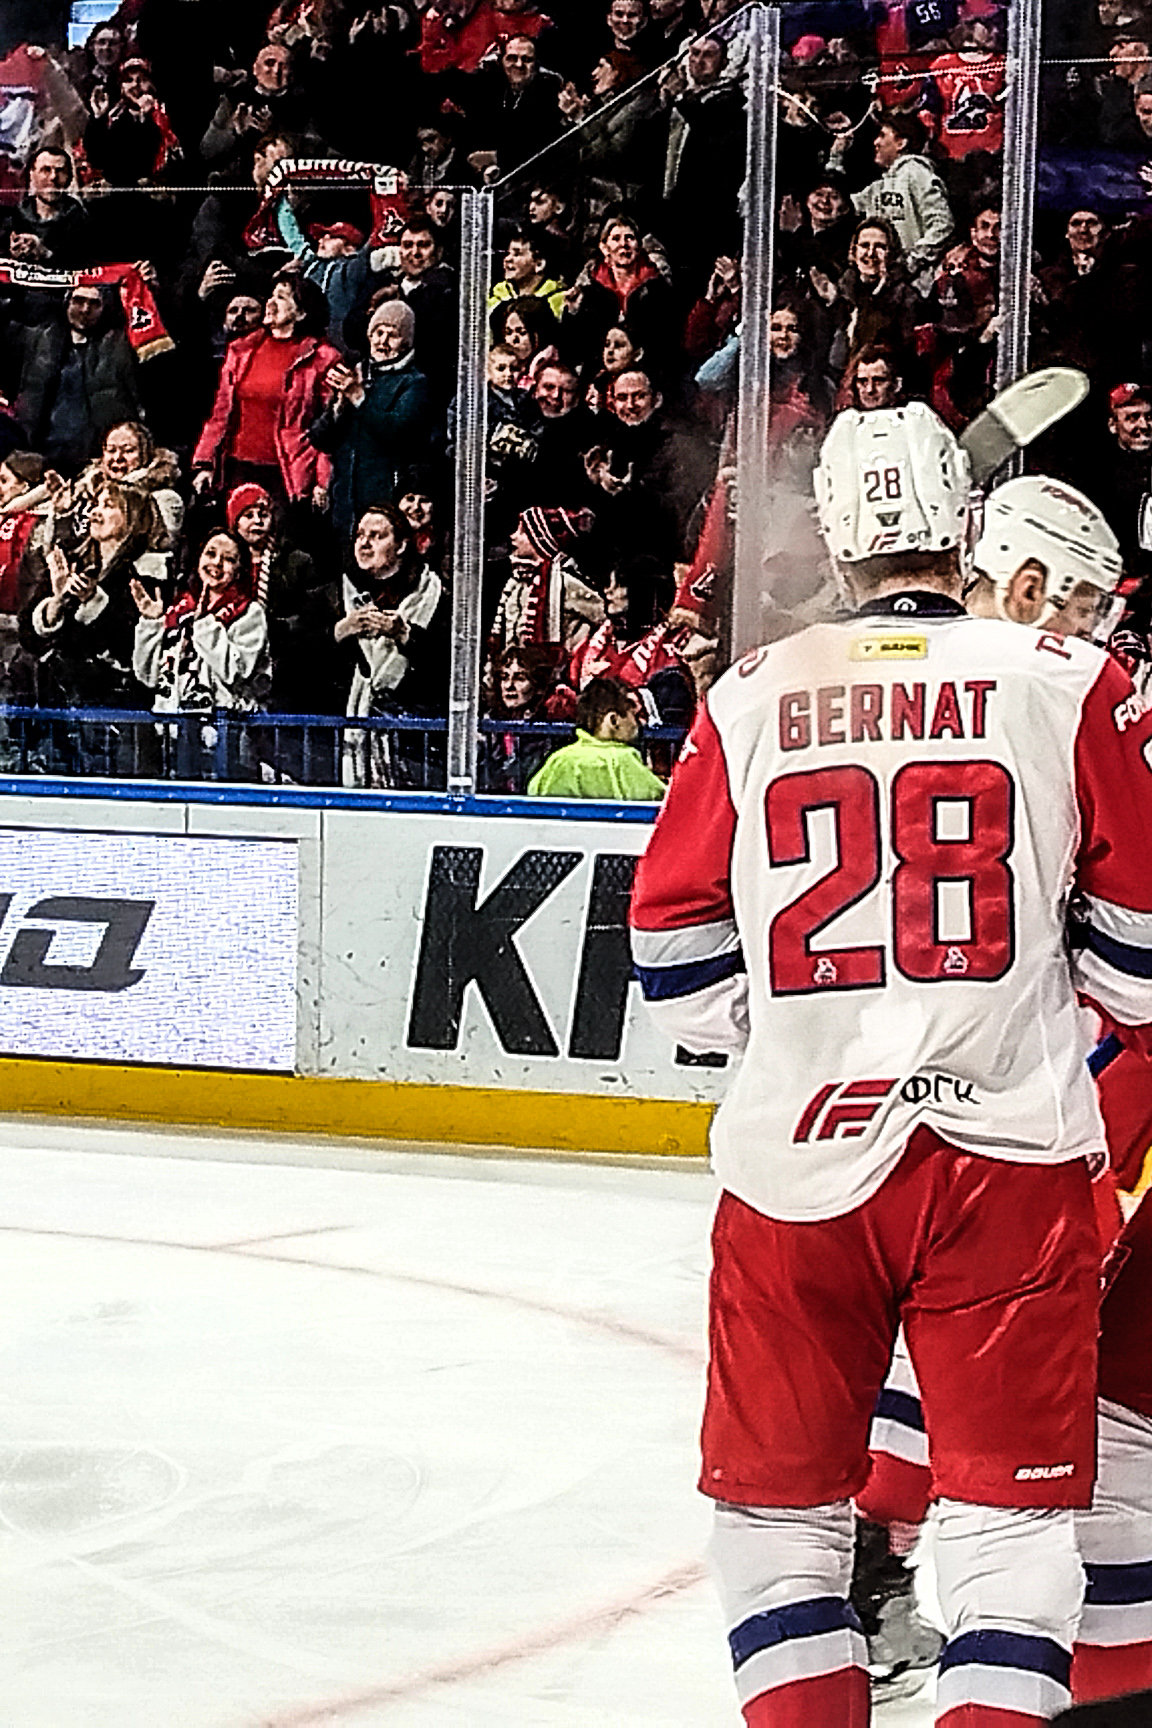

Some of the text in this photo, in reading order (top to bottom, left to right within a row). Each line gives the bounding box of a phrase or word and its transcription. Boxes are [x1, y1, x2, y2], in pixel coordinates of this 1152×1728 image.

[863, 466, 902, 502] 28
[779, 680, 997, 752] GERNAT
[764, 760, 1015, 997] 28
